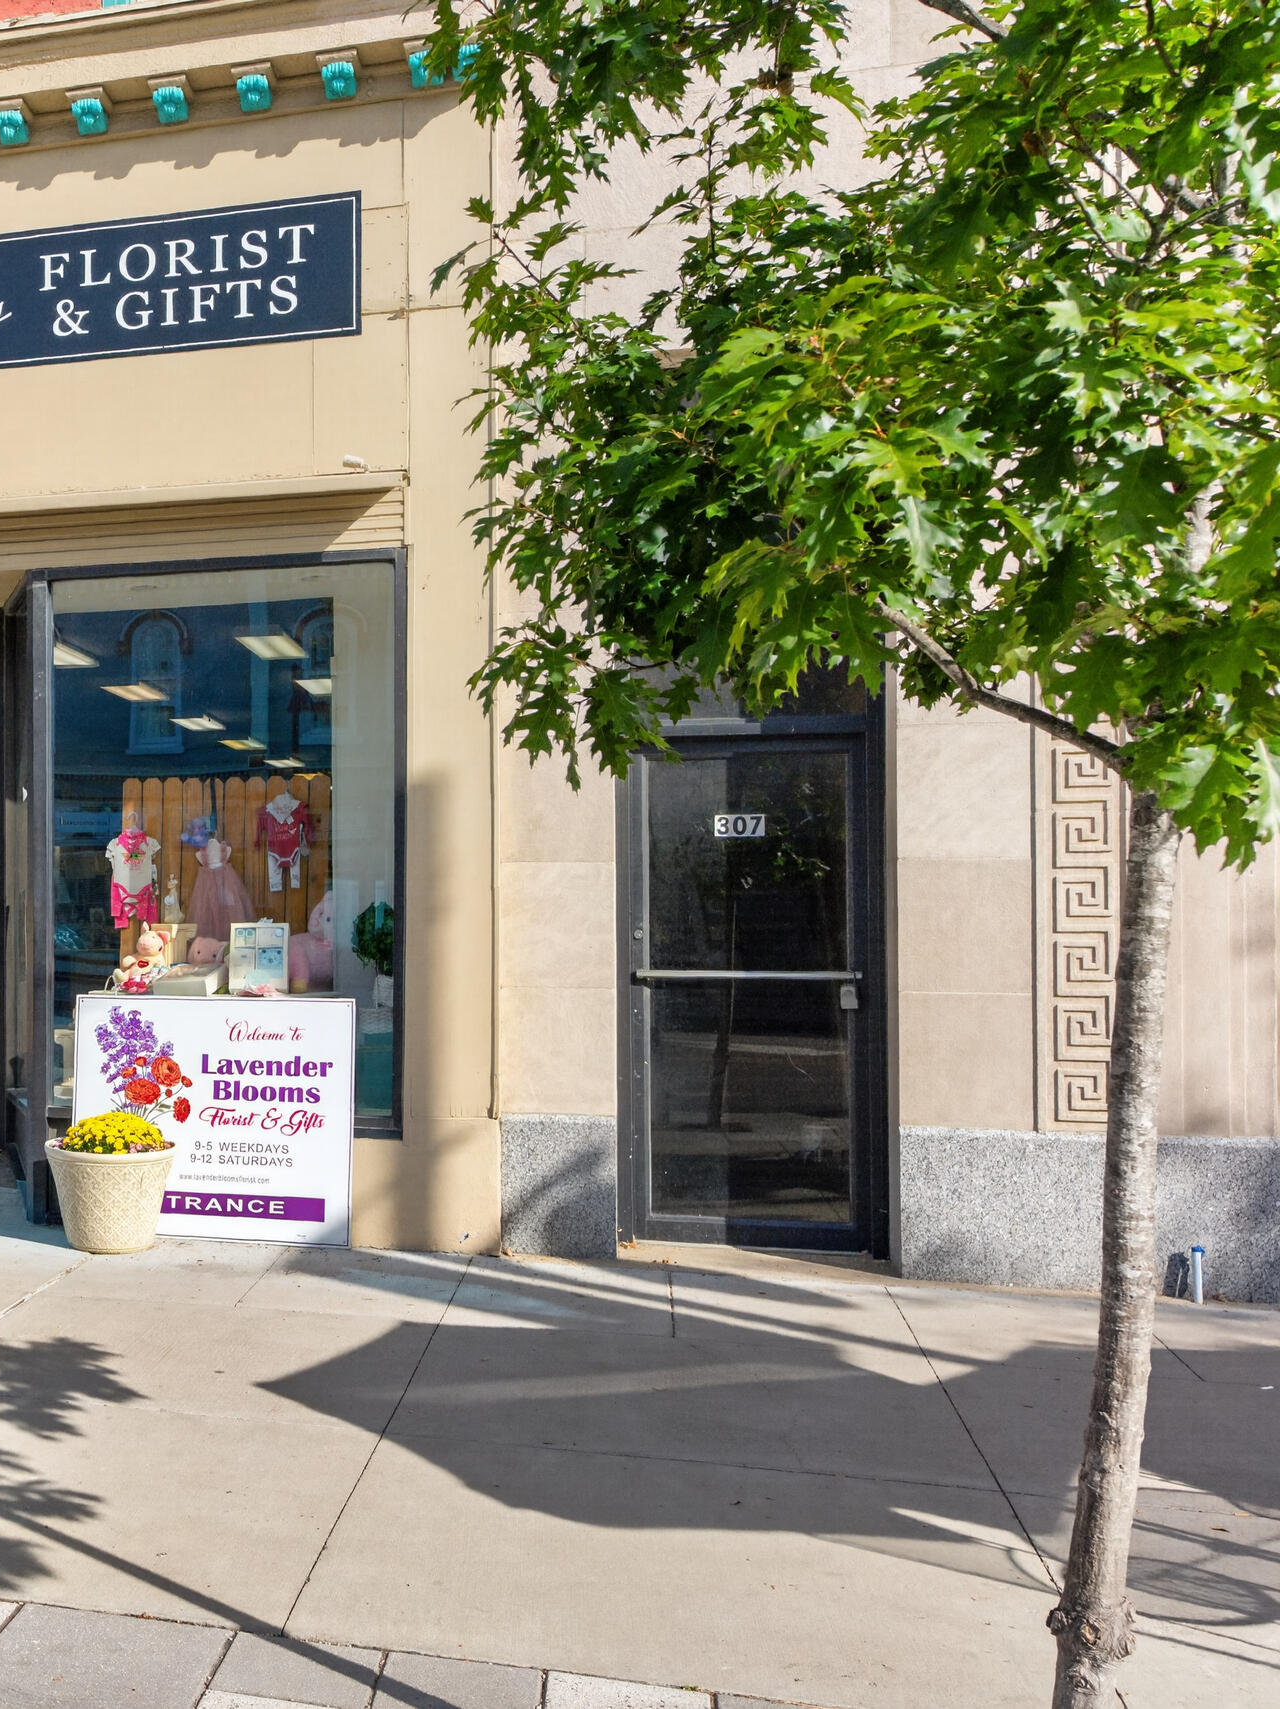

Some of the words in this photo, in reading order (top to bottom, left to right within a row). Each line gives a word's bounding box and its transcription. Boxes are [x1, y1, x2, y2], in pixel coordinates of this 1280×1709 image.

[38, 223, 316, 292] FLORIST
[51, 298, 90, 337] &
[114, 274, 299, 331] GIFTS
[716, 815, 763, 836] 307
[225, 1018, 286, 1042] Welcome
[289, 1026, 306, 1041] to
[201, 1053, 334, 1077] Lavender
[212, 1079, 321, 1104] Blooms
[199, 1106, 261, 1128] Florist
[261, 1107, 283, 1130] &
[280, 1109, 326, 1136] Gifts
[194, 1140, 213, 1151] 9-5
[218, 1141, 289, 1155] WEEKDAYS
[190, 1153, 213, 1164] 9-12
[218, 1154, 294, 1168] SATURDAYS
[166, 1195, 285, 1215] TRANCE
